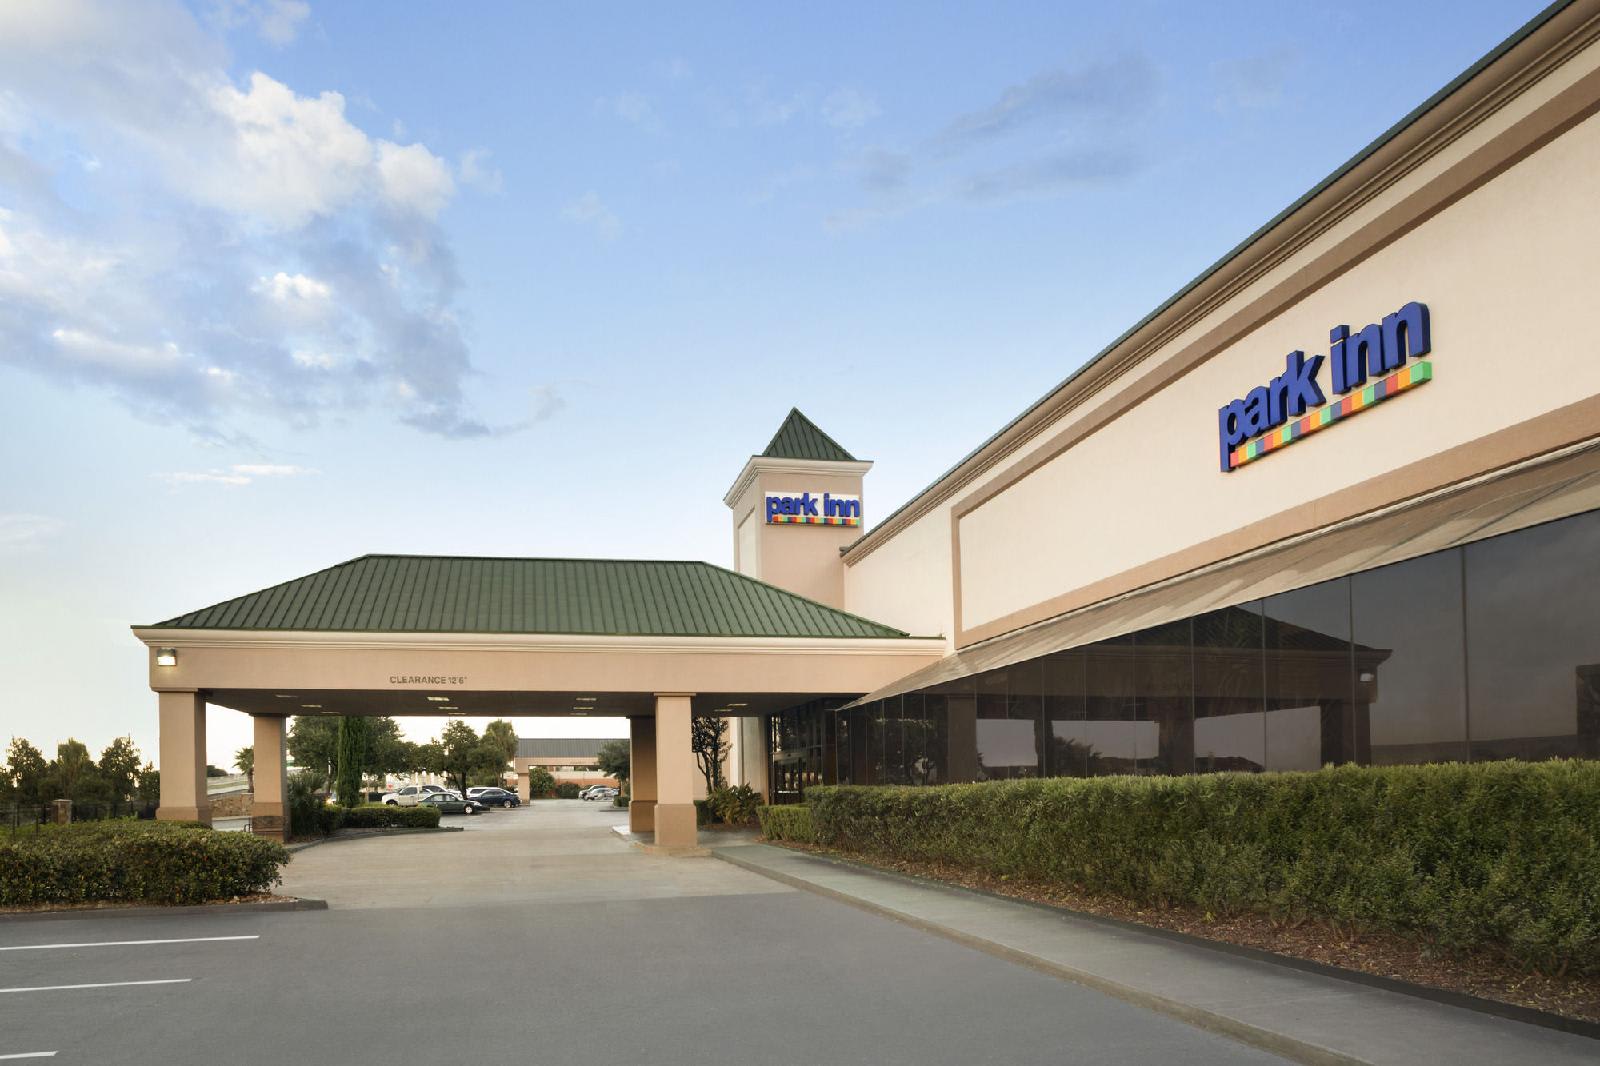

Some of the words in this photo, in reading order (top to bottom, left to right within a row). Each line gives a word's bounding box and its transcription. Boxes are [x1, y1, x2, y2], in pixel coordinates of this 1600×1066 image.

[1218, 350, 1327, 473] park
[1329, 301, 1432, 395] inn
[765, 492, 819, 523] park
[823, 492, 861, 518] inn
[389, 675, 447, 685] CLEARANCE
